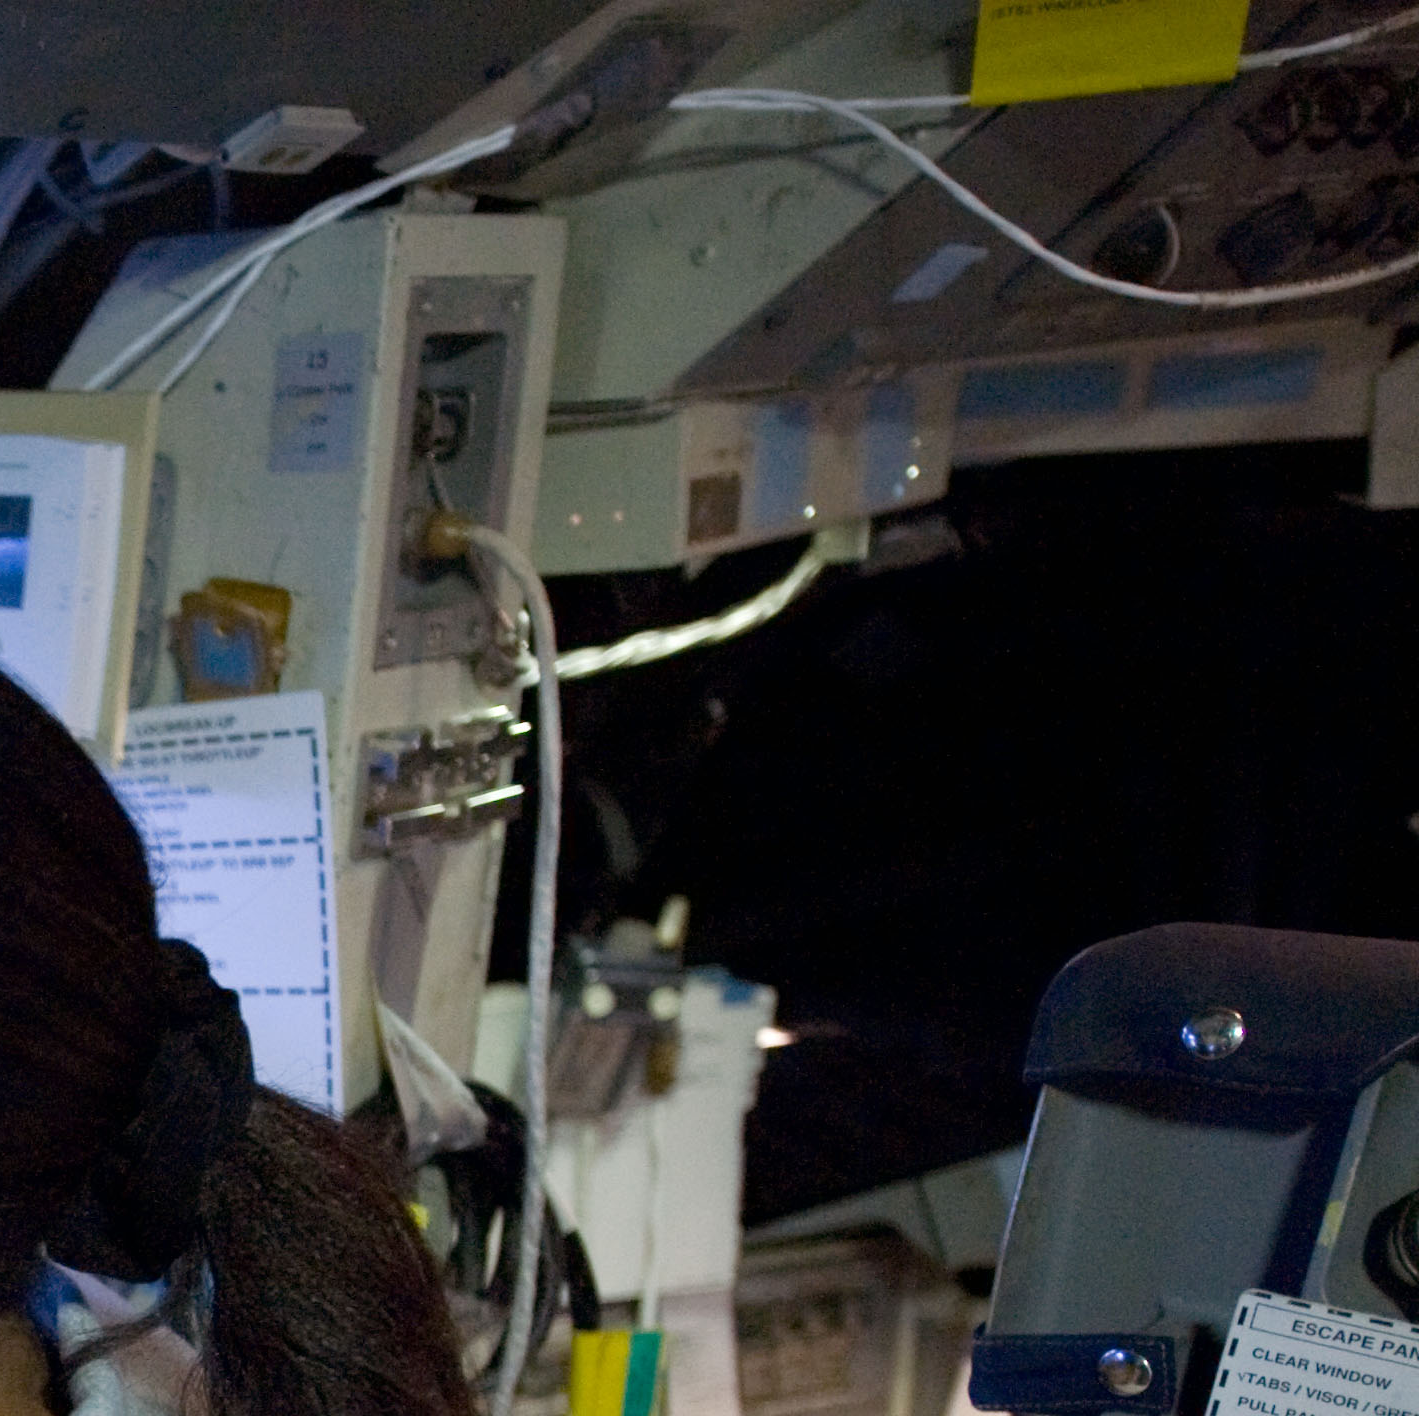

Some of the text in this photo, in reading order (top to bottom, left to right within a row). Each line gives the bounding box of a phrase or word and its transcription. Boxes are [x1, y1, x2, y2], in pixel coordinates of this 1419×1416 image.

[1290, 1319, 1376, 1350] ESCAPE
[1252, 1347, 1393, 1390] CLEAR WINDOW
[1238, 1396, 1279, 1416] PULL
[1306, 1386, 1359, 1411] VISOR
